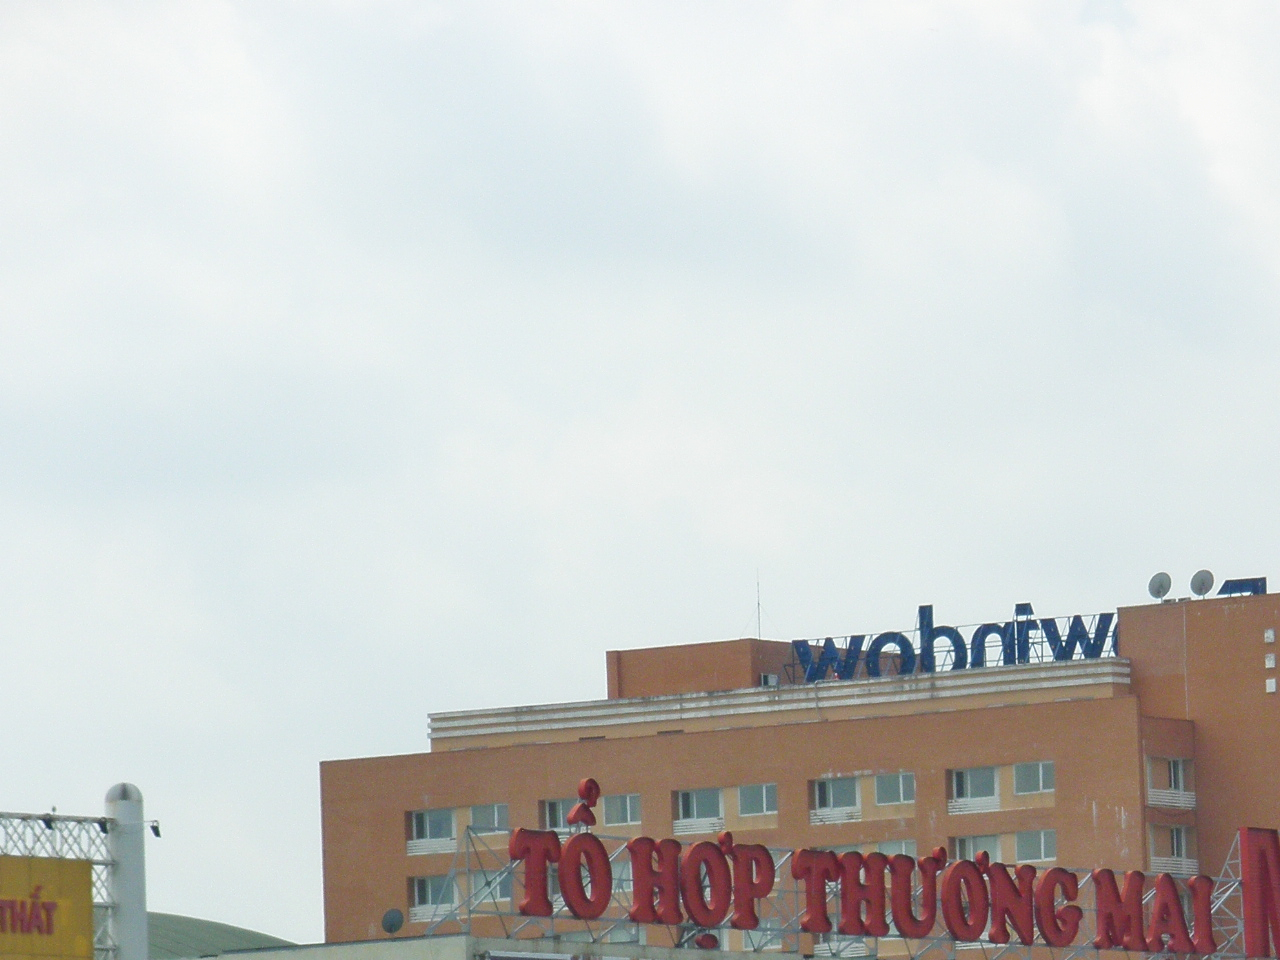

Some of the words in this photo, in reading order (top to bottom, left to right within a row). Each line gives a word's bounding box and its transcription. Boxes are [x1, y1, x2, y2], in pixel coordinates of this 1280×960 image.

[509, 778, 613, 920] TỔ
[627, 831, 775, 949] HỢP
[791, 846, 1083, 947] THƯƠNG
